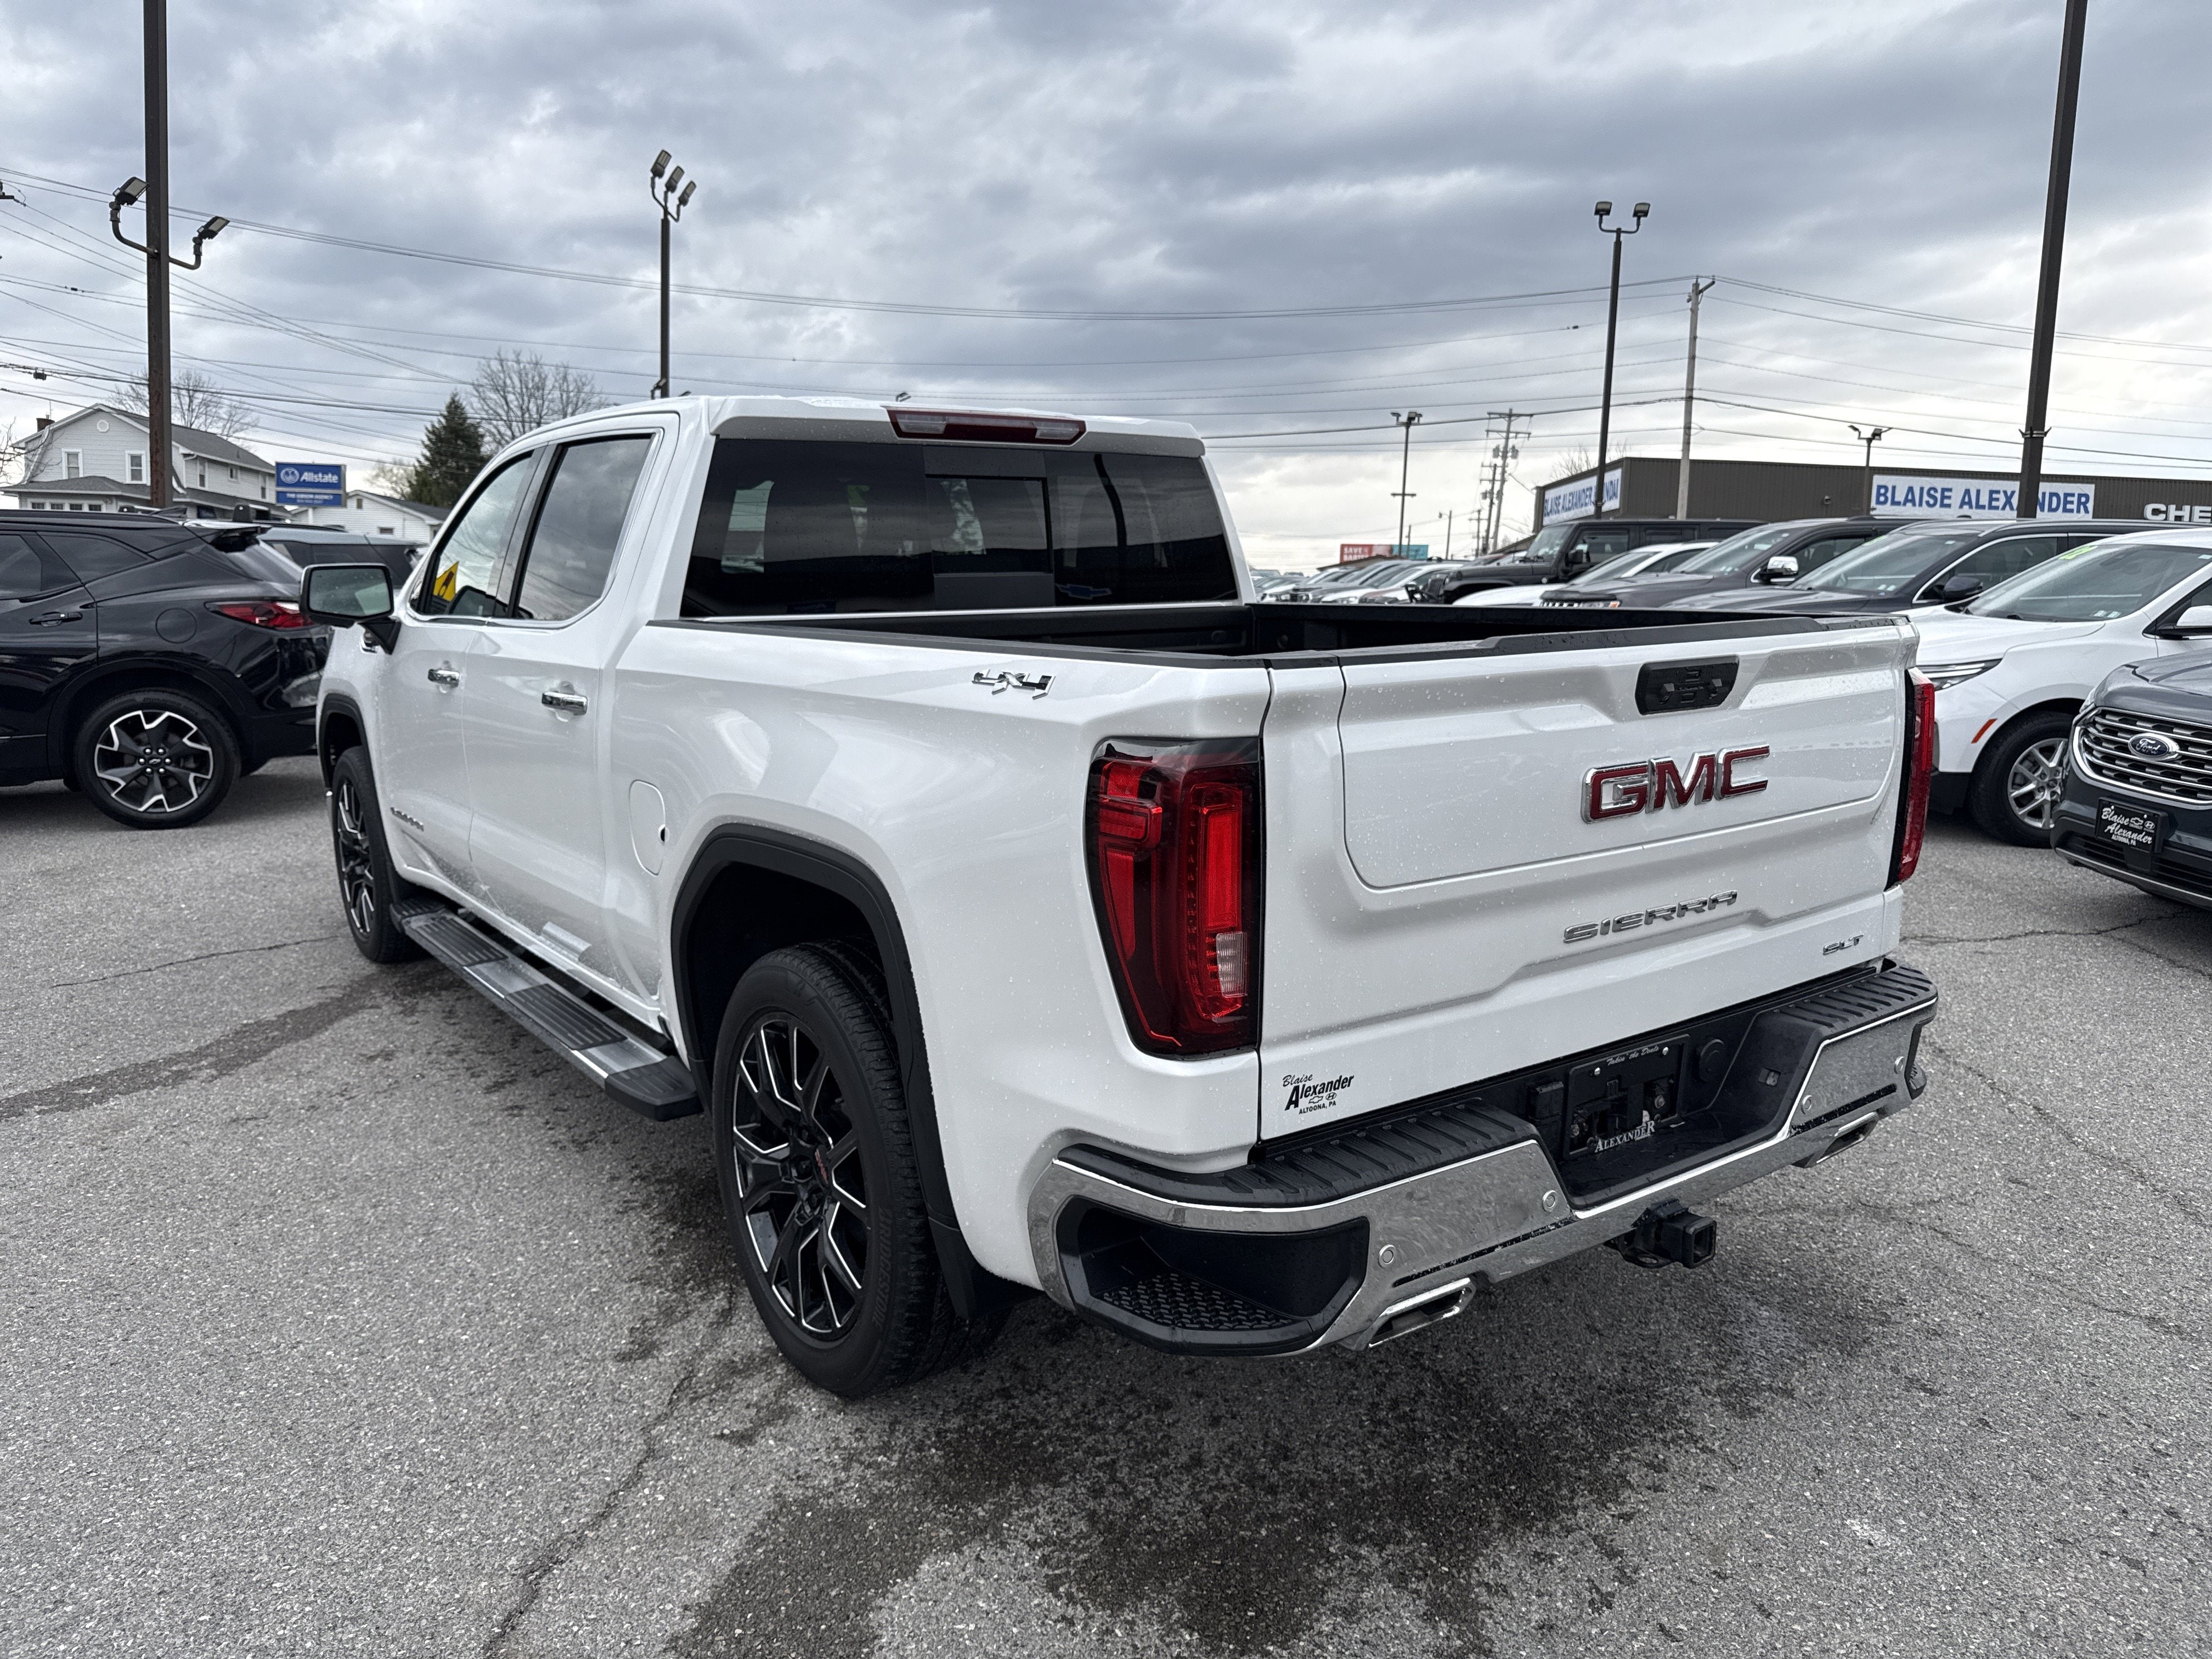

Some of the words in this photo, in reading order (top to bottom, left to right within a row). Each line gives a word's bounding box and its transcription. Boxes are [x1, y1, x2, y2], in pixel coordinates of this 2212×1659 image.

[300, 471, 339, 483] Allstate
[1544, 495, 1561, 517] BLAISE
[1561, 487, 1593, 513] ALEXANDER
[1875, 484, 1953, 508] BLAISE
[1959, 488, 2090, 515] ALEXNDER
[2136, 738, 2161, 754] Ford
[1581, 743, 1770, 824] GMC
[2101, 807, 2130, 826] Blaise
[2104, 822, 2152, 844] Alexander
[1564, 889, 1737, 943] SIERRA
[1822, 934, 1864, 955] SLT
[1282, 1074, 1313, 1087] Blaise
[1284, 1075, 1355, 1111] Alexander
[1299, 1103, 1328, 1115] ALTOONA,
